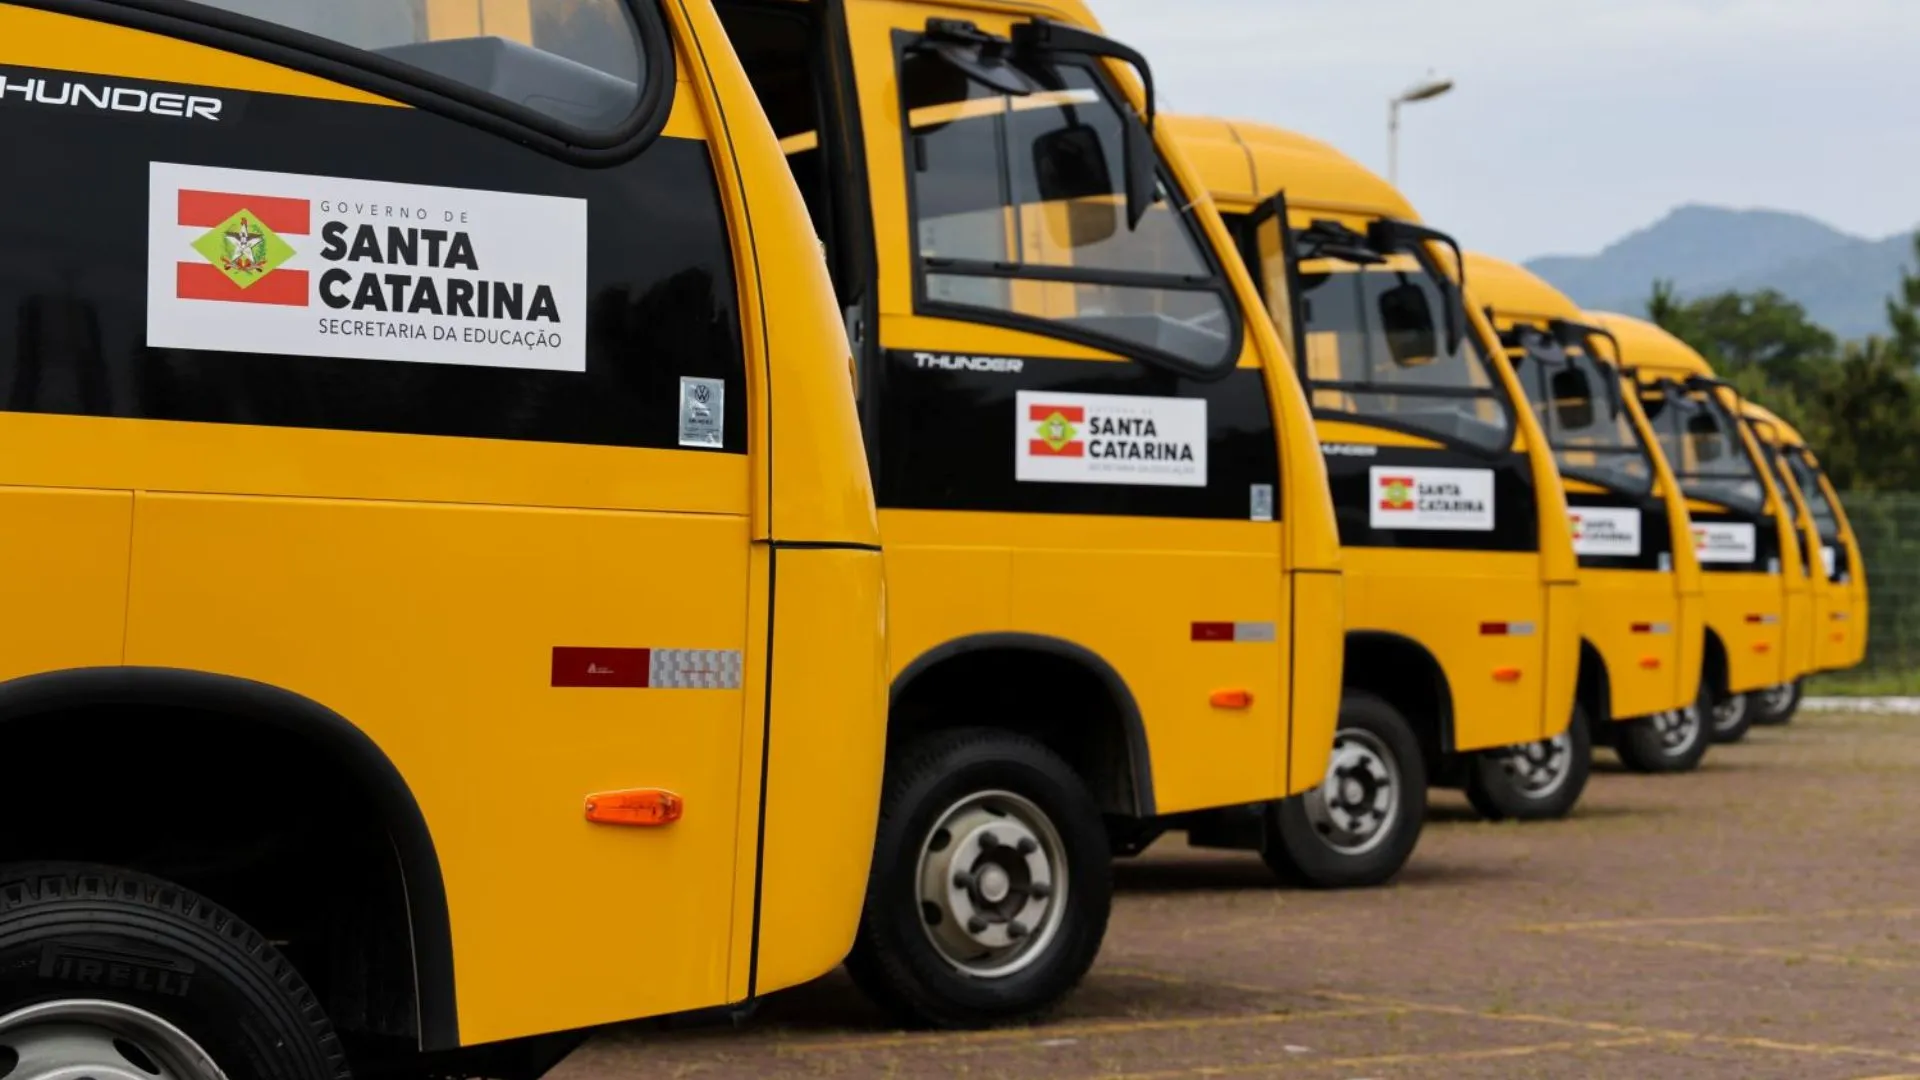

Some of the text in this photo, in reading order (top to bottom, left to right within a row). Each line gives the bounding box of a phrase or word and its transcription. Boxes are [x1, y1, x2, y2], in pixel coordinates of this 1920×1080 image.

[0, 75, 223, 122] HUNDER
[320, 200, 469, 224] GOVERNO DE
[319, 220, 480, 271] SANTA
[318, 267, 562, 323] CATARINA
[318, 318, 562, 350] SECRETARIA DA EDUCAÇÃO
[914, 352, 1024, 373] THUNDER
[1088, 416, 1158, 438] SANTA
[1088, 440, 1194, 463] CATARINA
[38, 941, 195, 997] PIRELLI
